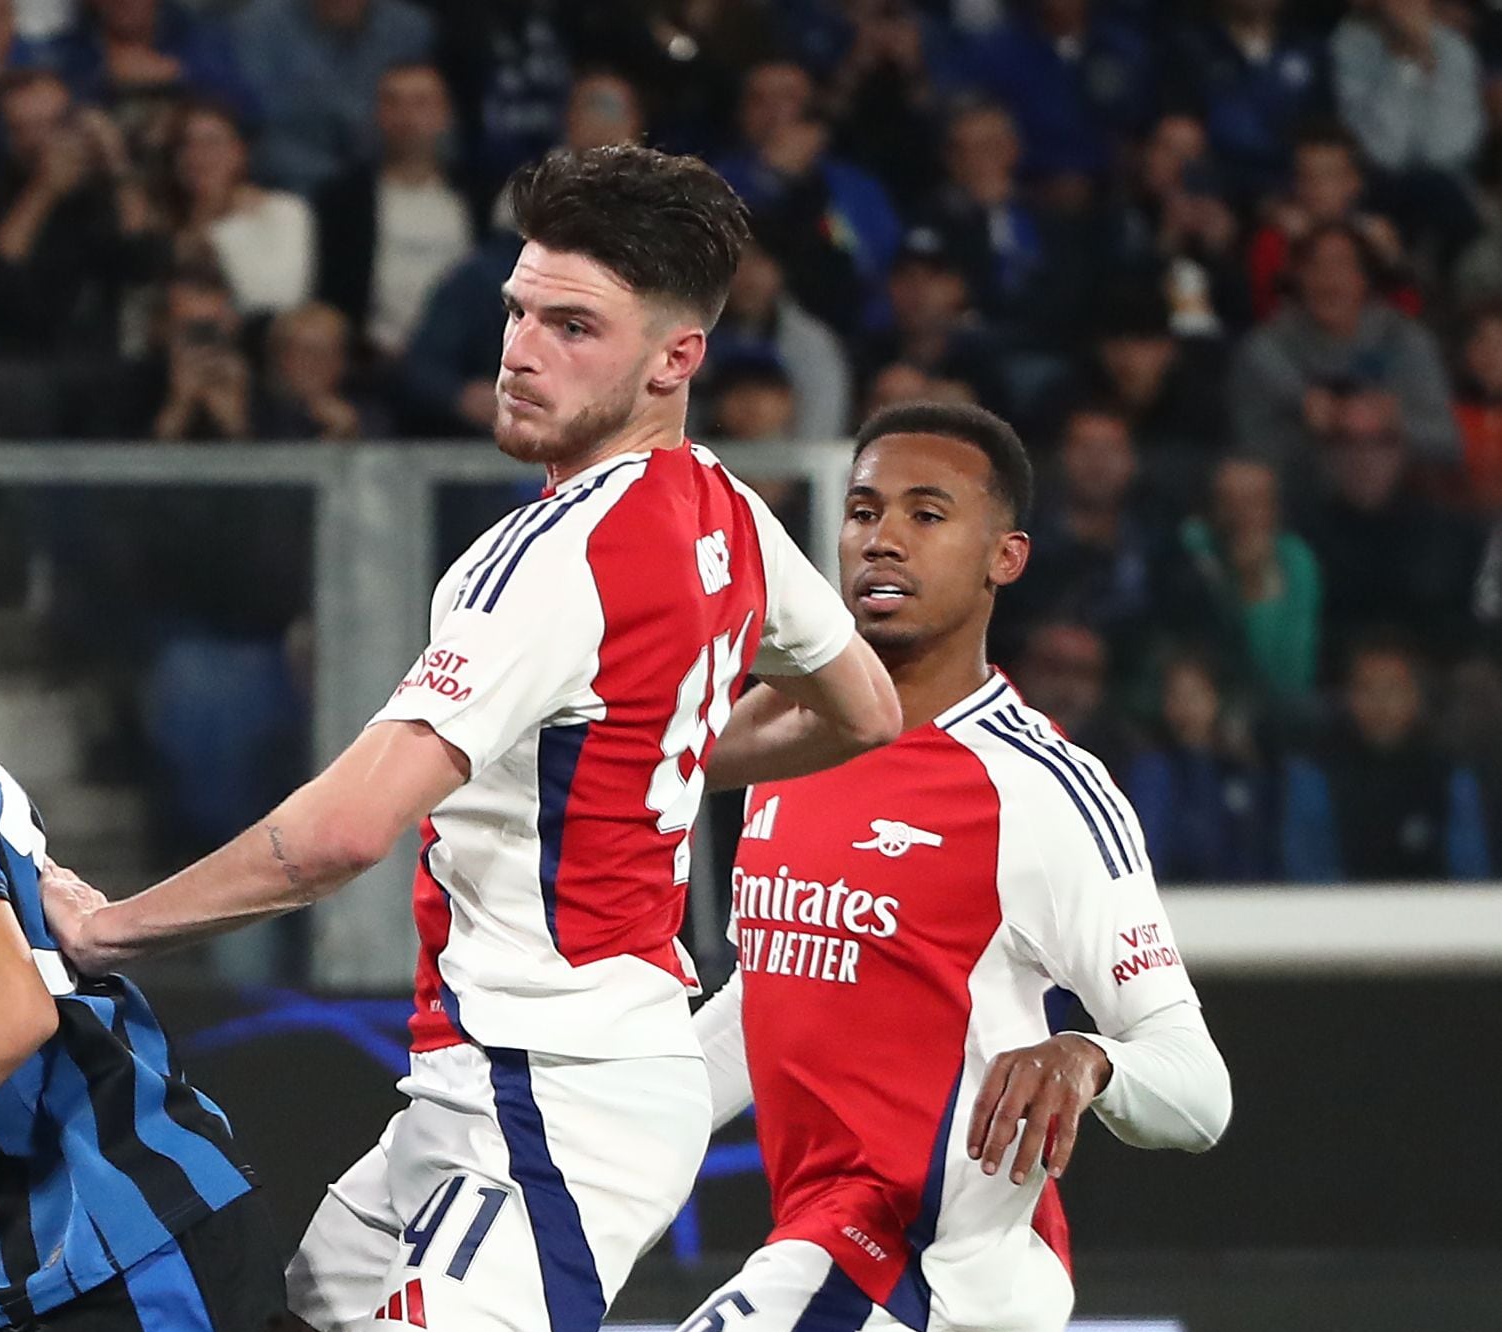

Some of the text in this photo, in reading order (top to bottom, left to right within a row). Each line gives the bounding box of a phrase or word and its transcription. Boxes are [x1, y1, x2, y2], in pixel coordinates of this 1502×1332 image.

[732, 865, 900, 938] Emirates
[741, 927, 861, 984] FLY BETTER
[1119, 922, 1160, 948] VISIT
[401, 1174, 511, 1283] 41
